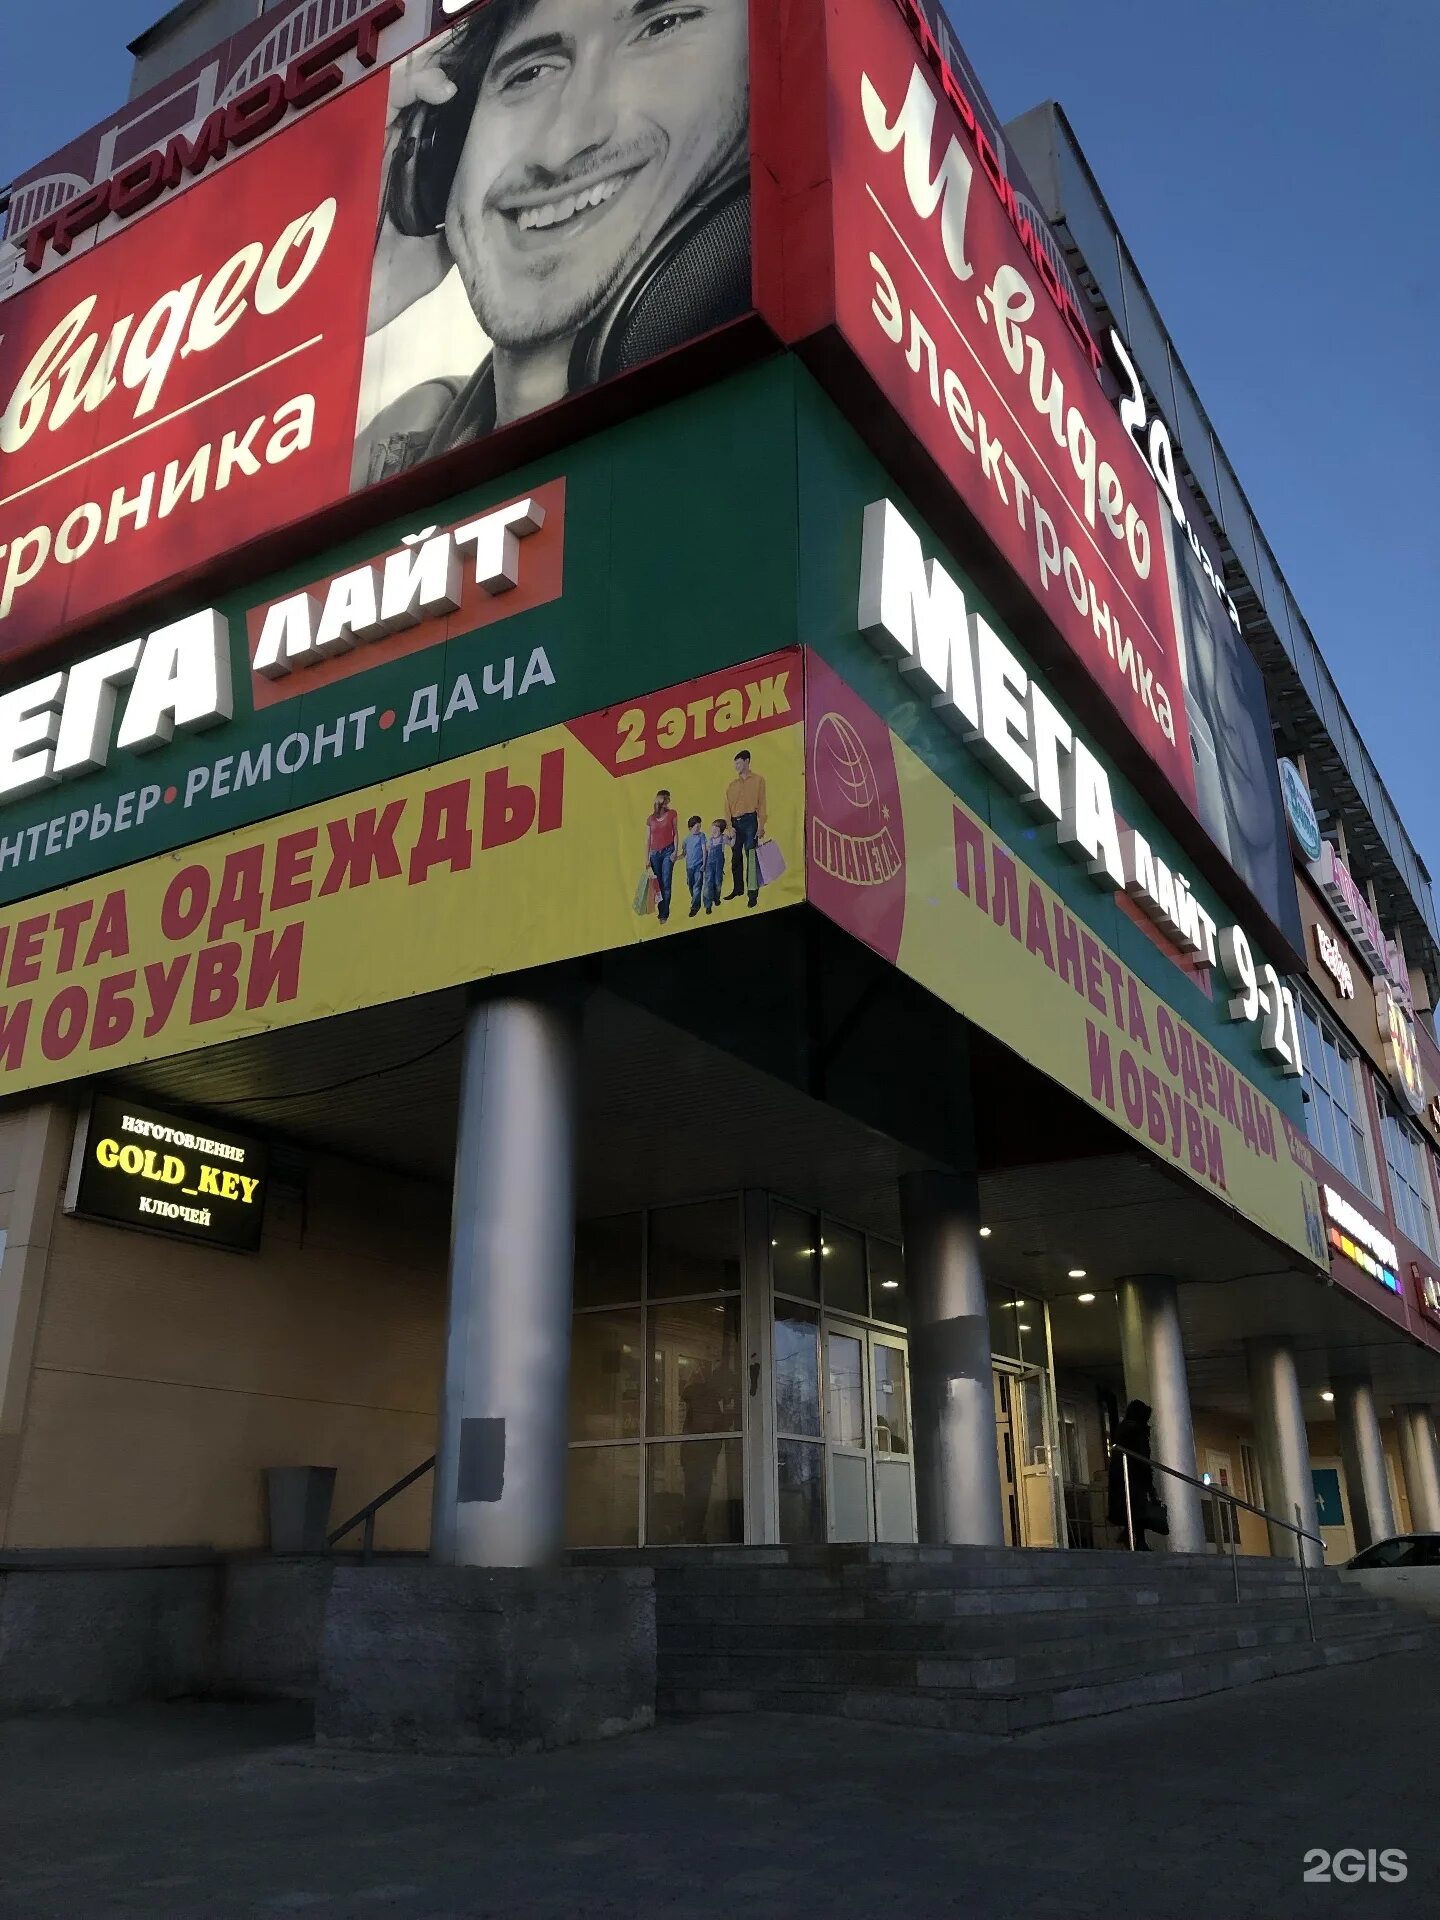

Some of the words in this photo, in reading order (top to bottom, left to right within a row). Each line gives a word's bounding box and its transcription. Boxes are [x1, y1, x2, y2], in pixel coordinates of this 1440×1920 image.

[0, 393, 316, 619] роника
[252, 497, 540, 676] ЛАЙТ
[184, 706, 376, 809] РЕМОНТ
[403, 646, 556, 742] ДАЧА
[615, 708, 647, 764] 2
[656, 671, 792, 750] этаж
[866, 498, 1125, 890] МЕГА
[1129, 829, 1217, 967] ЛАЙТ
[1226, 924, 1303, 1078] 9-21
[161, 748, 565, 943] ОДЕЖДЫ
[813, 818, 901, 885] ПЛАНЕТА
[41, 921, 305, 1061] ОБУВИ
[952, 803, 1152, 1055] ПЛАНЕТА
[1156, 1005, 1278, 1162] ОДЕЖДЫ
[96, 1138, 260, 1204] GOLD_KEY
[121, 1115, 245, 1163] ИЗГОТОВЛЕНИЕ
[1085, 1017, 1116, 1112] И
[1119, 1049, 1227, 1192] ОБУВИ
[139, 1196, 212, 1226] КЛЮЧЕЙ
